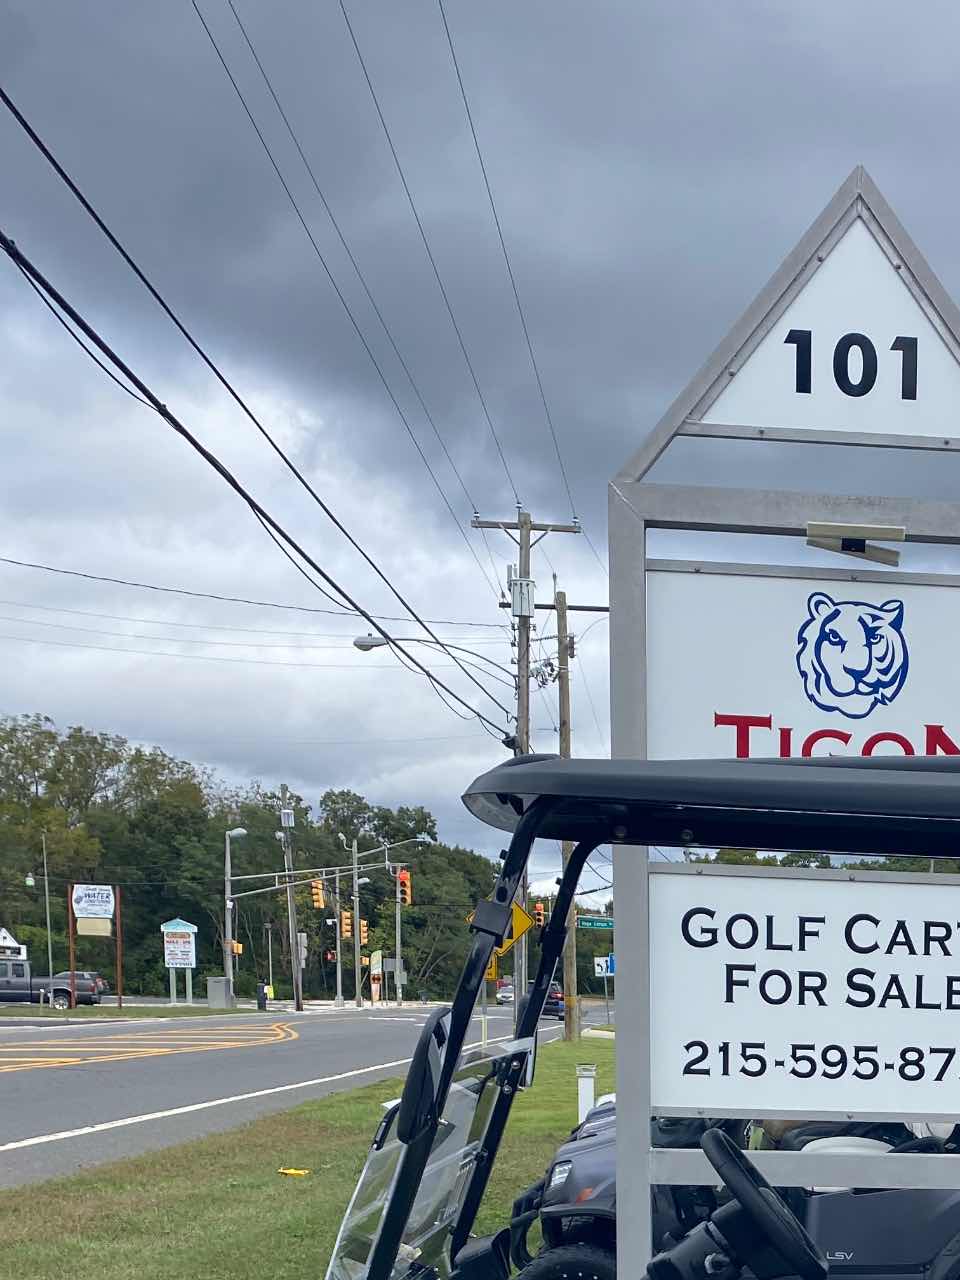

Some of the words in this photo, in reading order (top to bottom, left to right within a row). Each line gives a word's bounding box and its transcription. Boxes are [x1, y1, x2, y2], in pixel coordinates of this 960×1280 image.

[784, 329, 918, 400] 101
[682, 907, 826, 952] GOLF
[724, 963, 828, 1007] FOR
[826, 1251, 854, 1262] LSV
